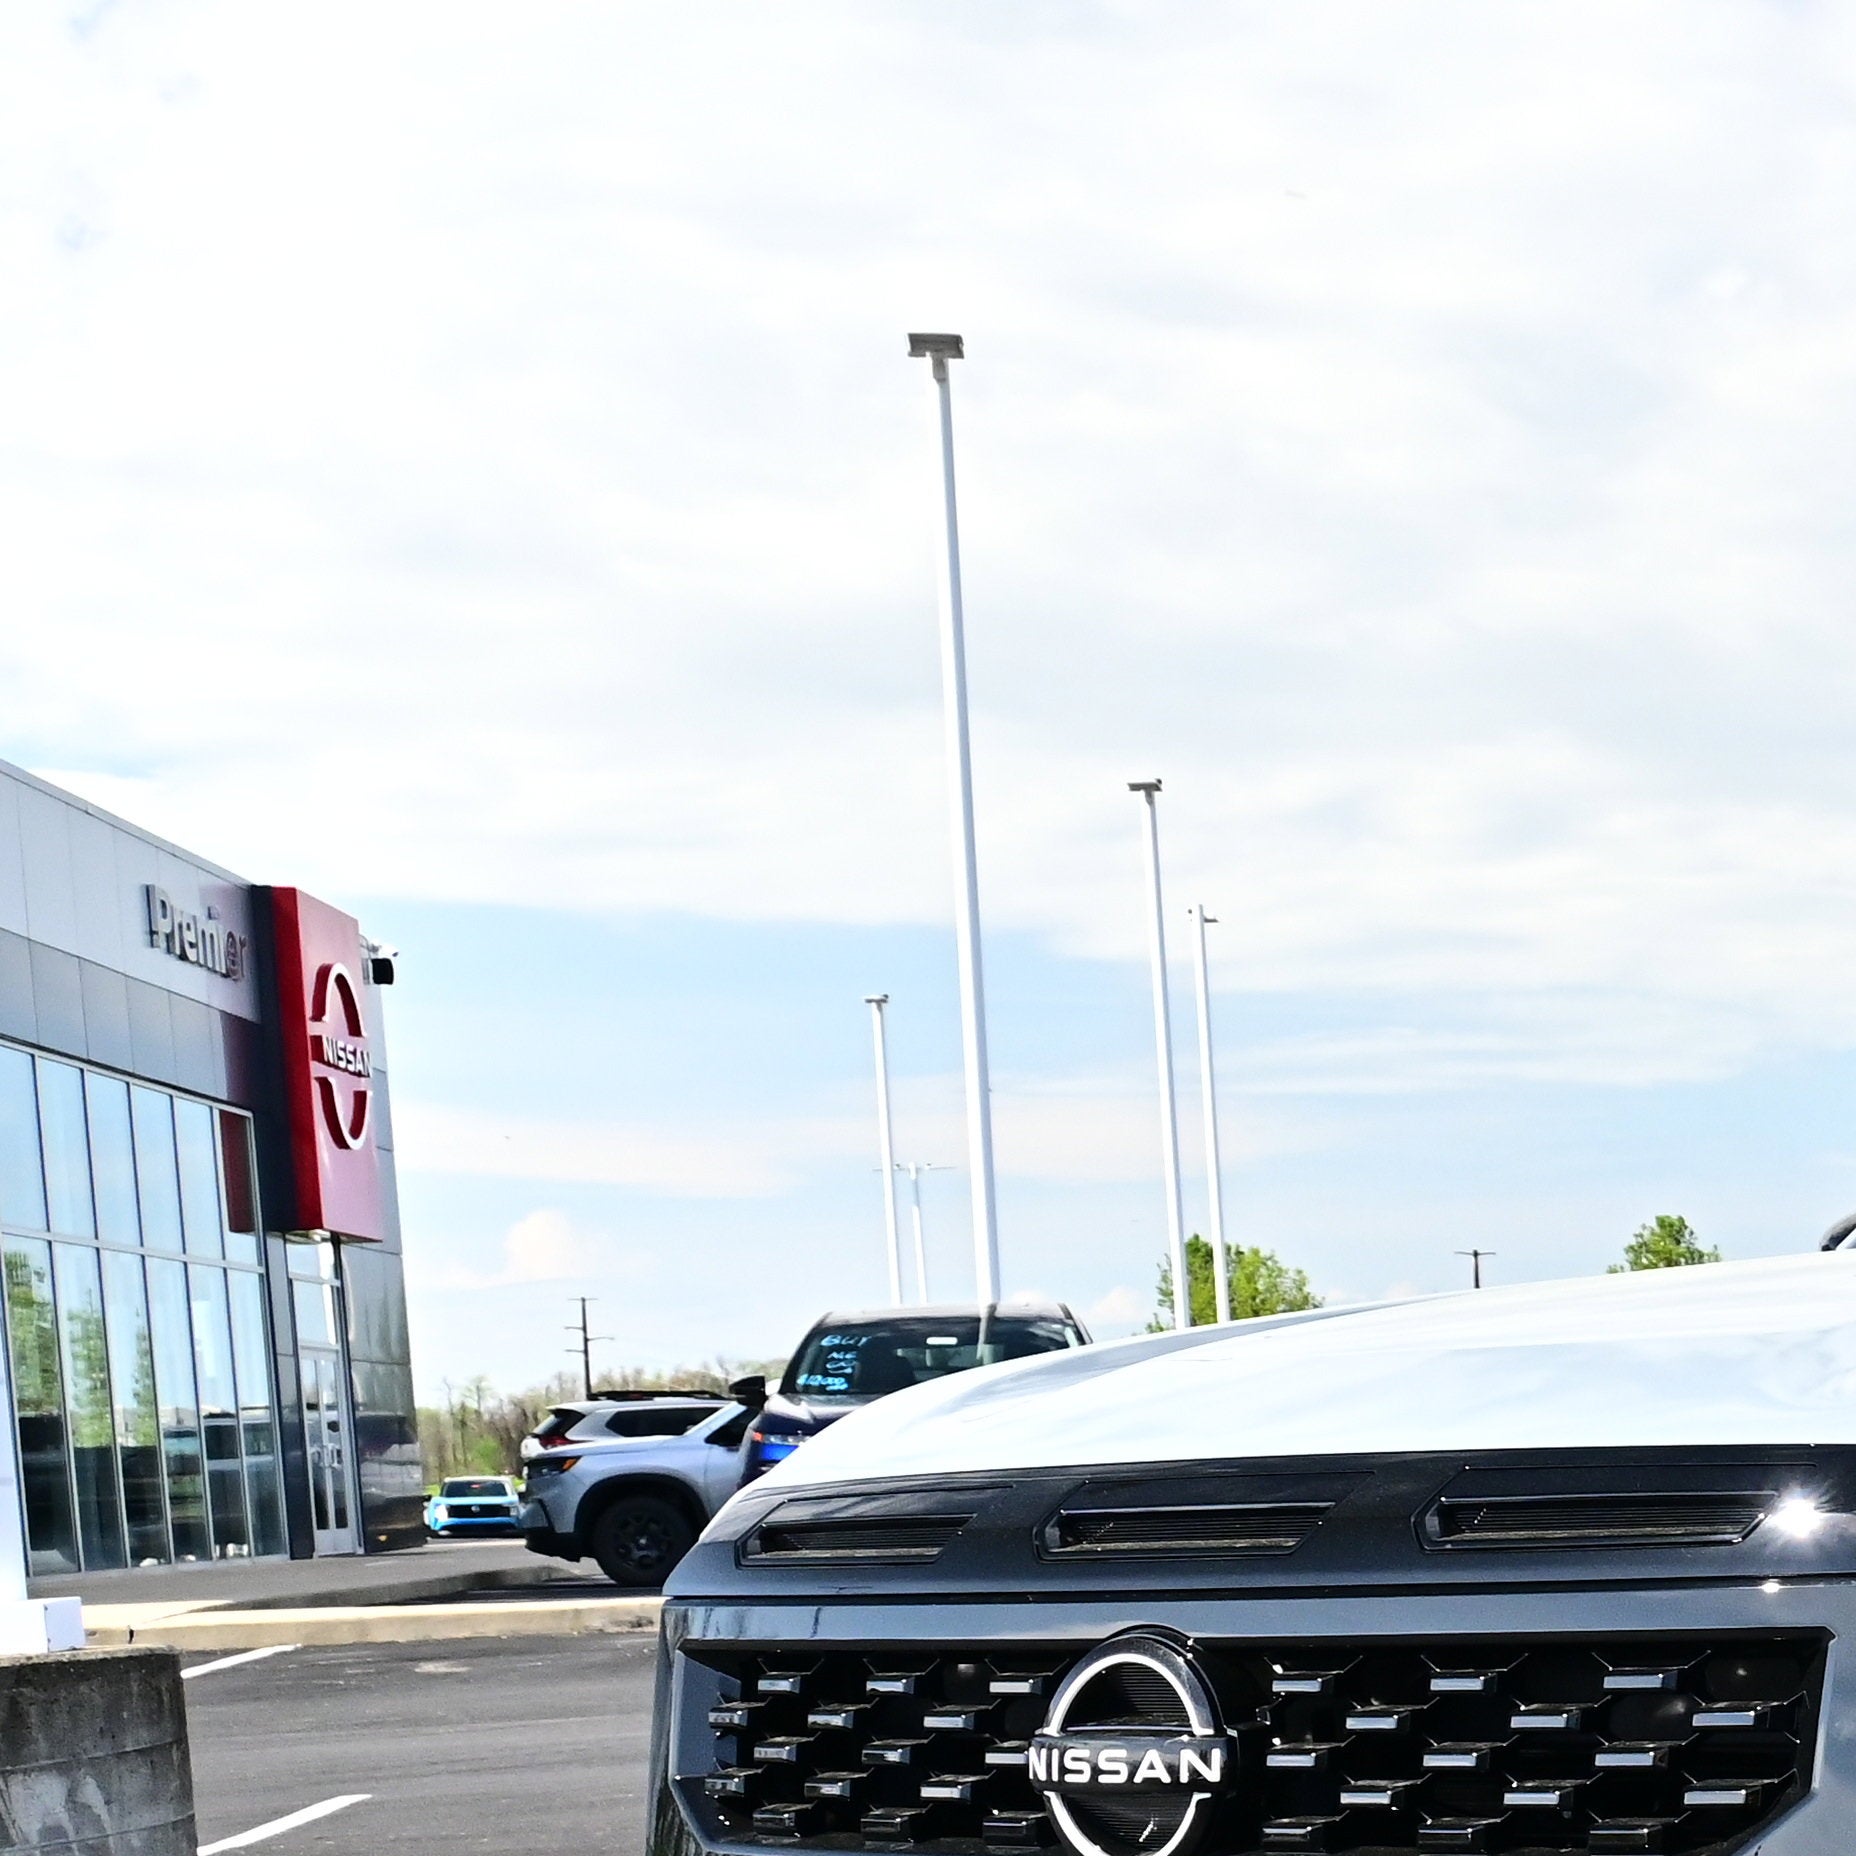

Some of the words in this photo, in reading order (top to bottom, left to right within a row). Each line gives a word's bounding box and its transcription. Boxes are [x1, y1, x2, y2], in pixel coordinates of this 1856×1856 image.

[142, 884, 247, 980] Premier
[323, 1036, 372, 1077] NISSAN
[1028, 1747, 1221, 1784] NISSAN
